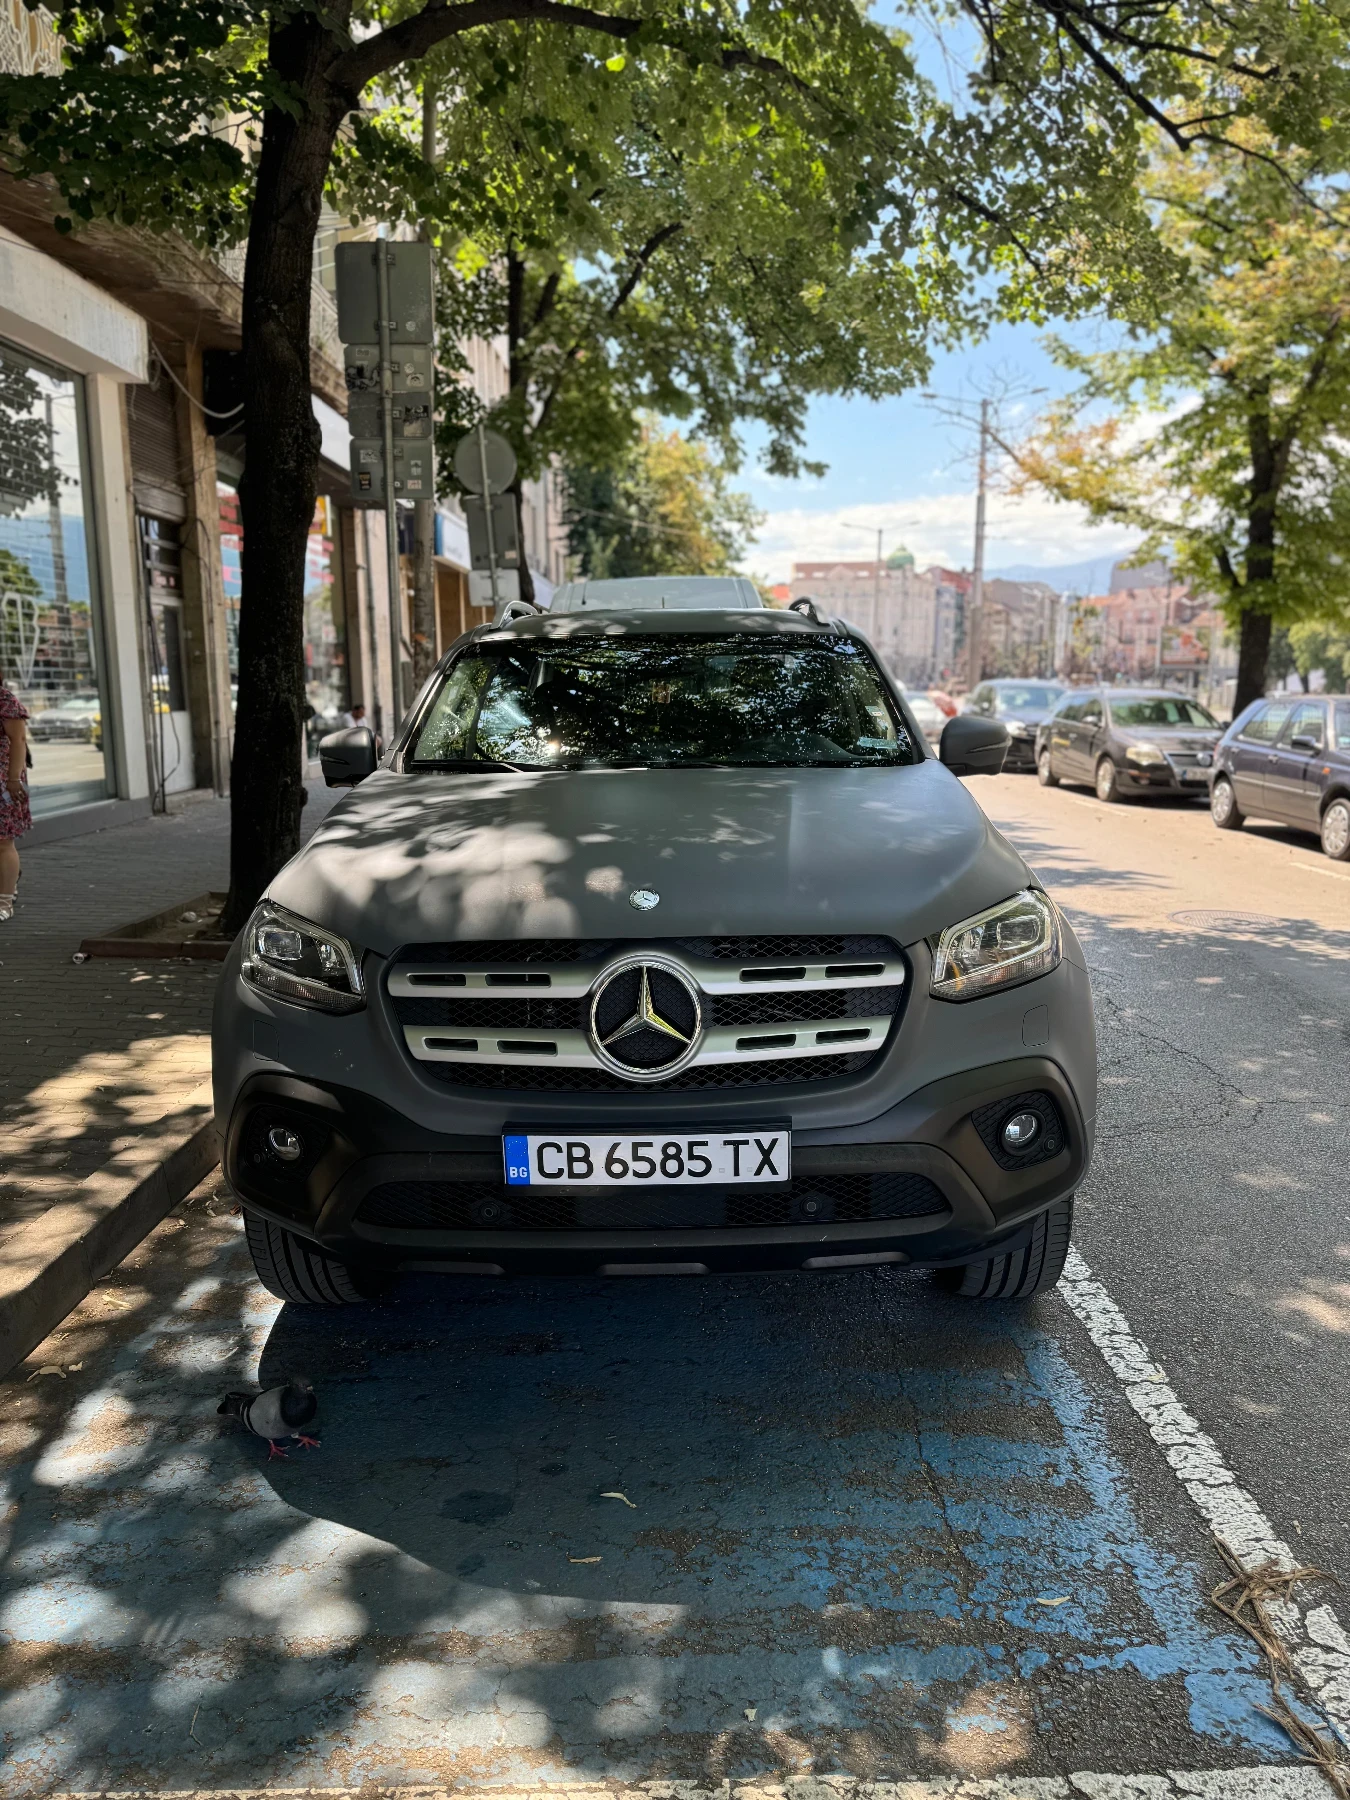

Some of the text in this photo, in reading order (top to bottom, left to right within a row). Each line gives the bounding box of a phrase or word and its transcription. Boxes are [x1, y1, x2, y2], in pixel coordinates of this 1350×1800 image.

[536, 1137, 780, 1179] CB 6585 TX
[509, 1166, 528, 1178] BG
